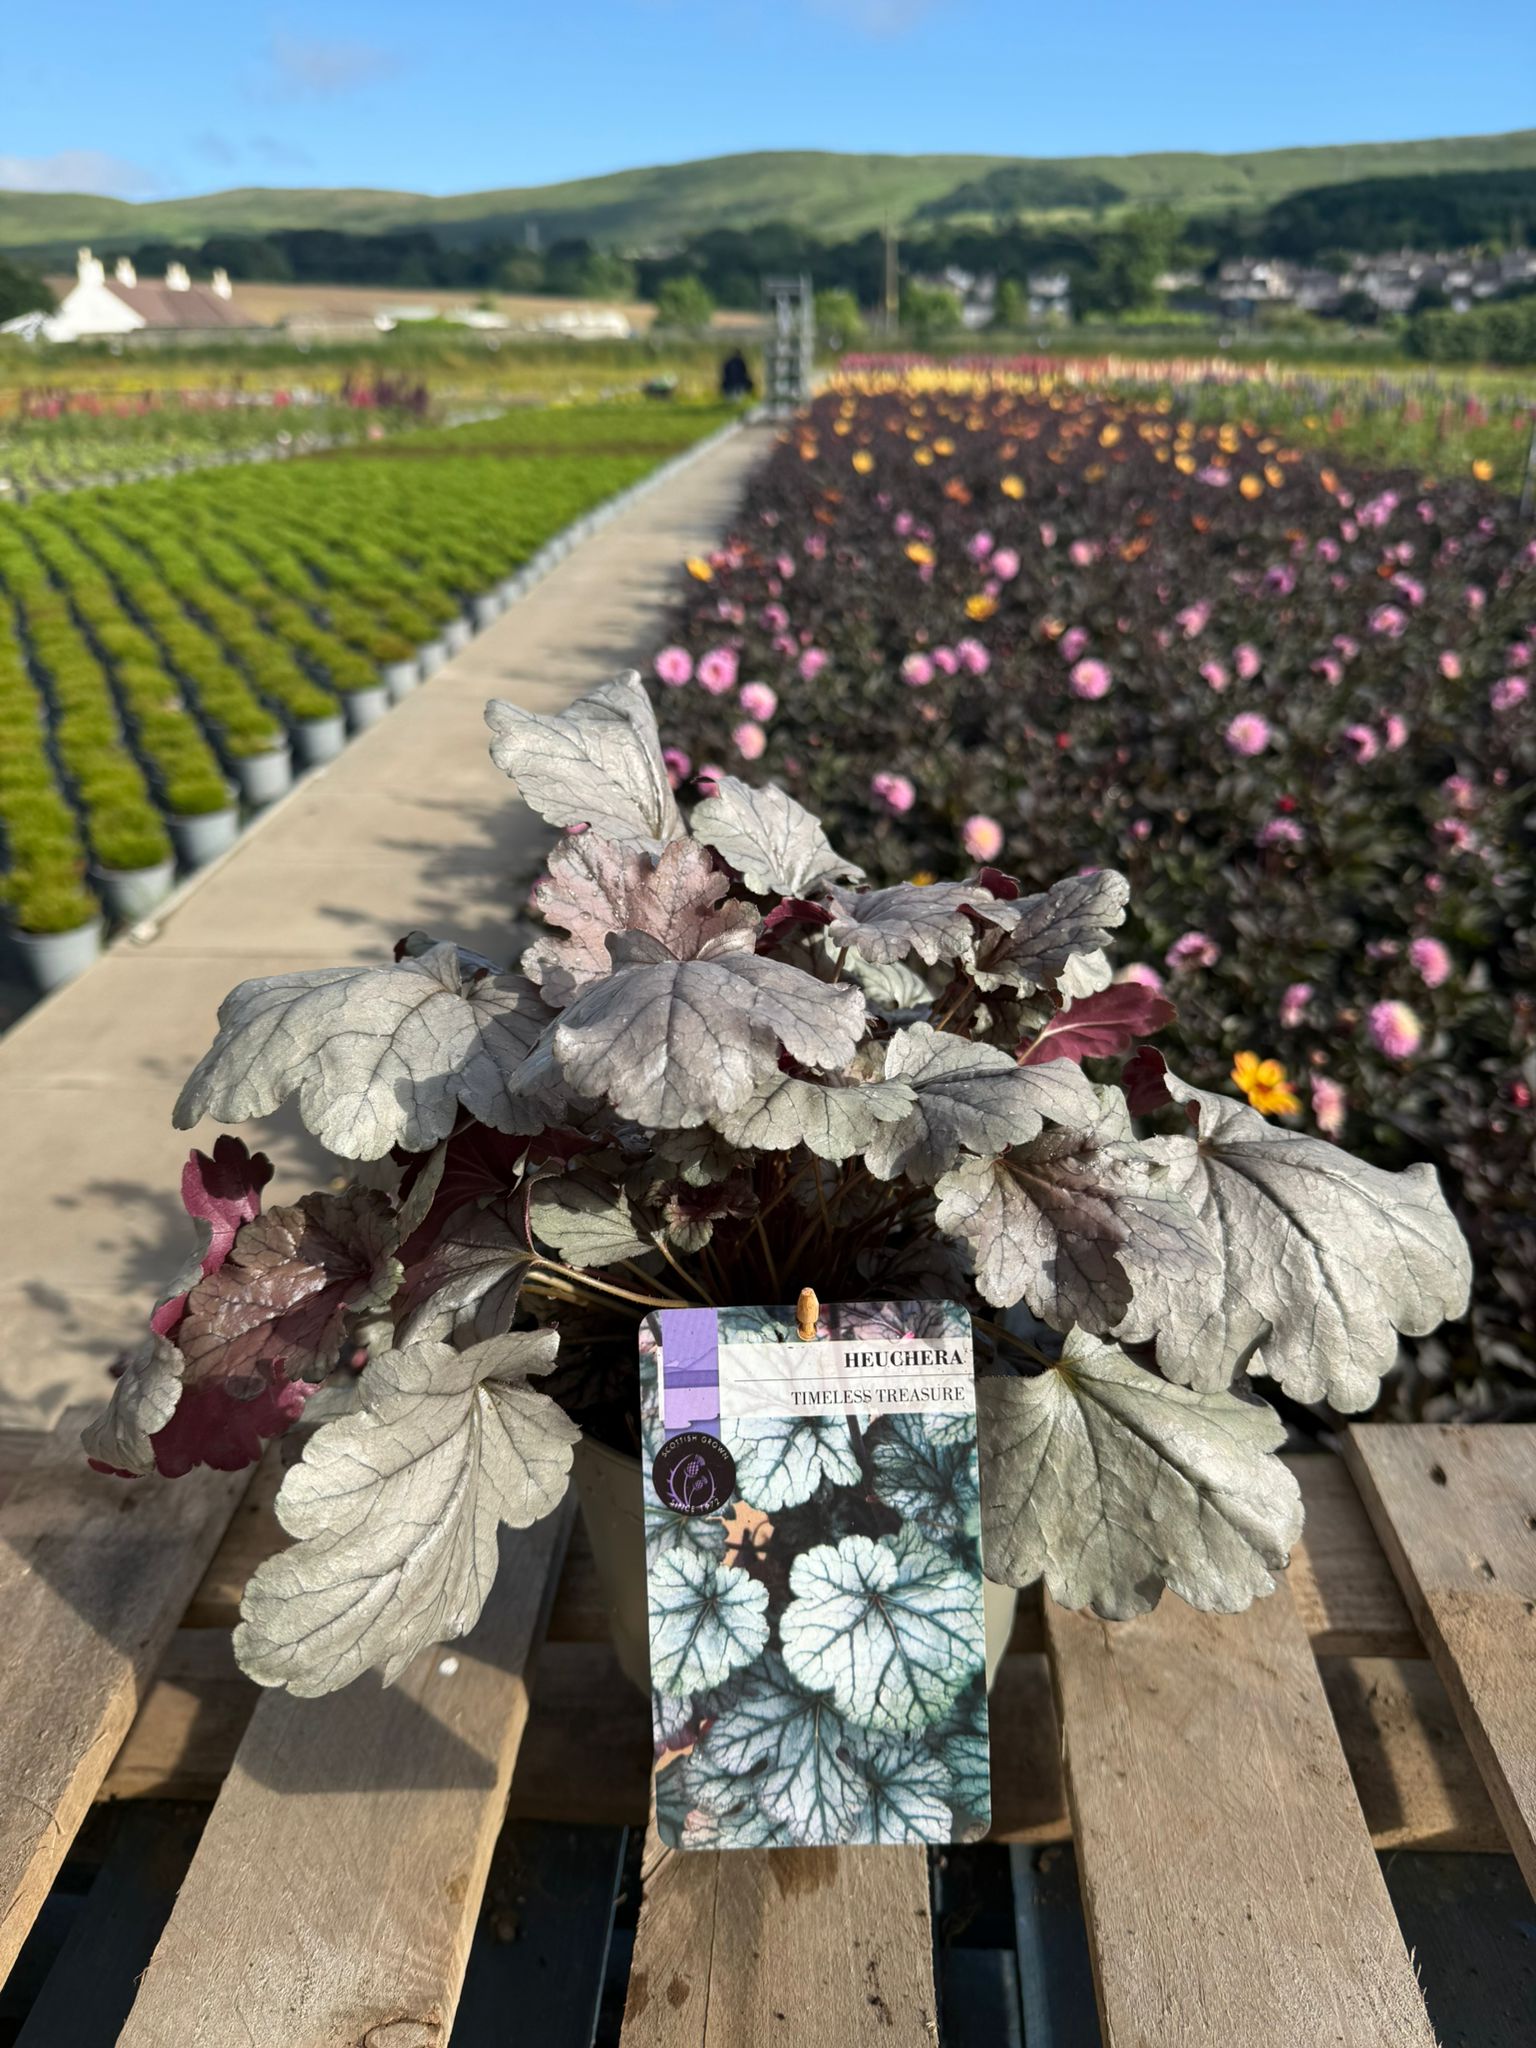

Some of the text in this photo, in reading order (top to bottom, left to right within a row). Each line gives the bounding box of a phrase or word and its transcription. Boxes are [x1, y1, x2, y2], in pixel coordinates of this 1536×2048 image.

[844, 1350, 963, 1367] HEUCHERA
[791, 1387, 965, 1405] TIMELESS TREASURE
[661, 1436, 729, 1459] SCOTTISH GROWN
[669, 1498, 720, 1512] SINCE 1972
